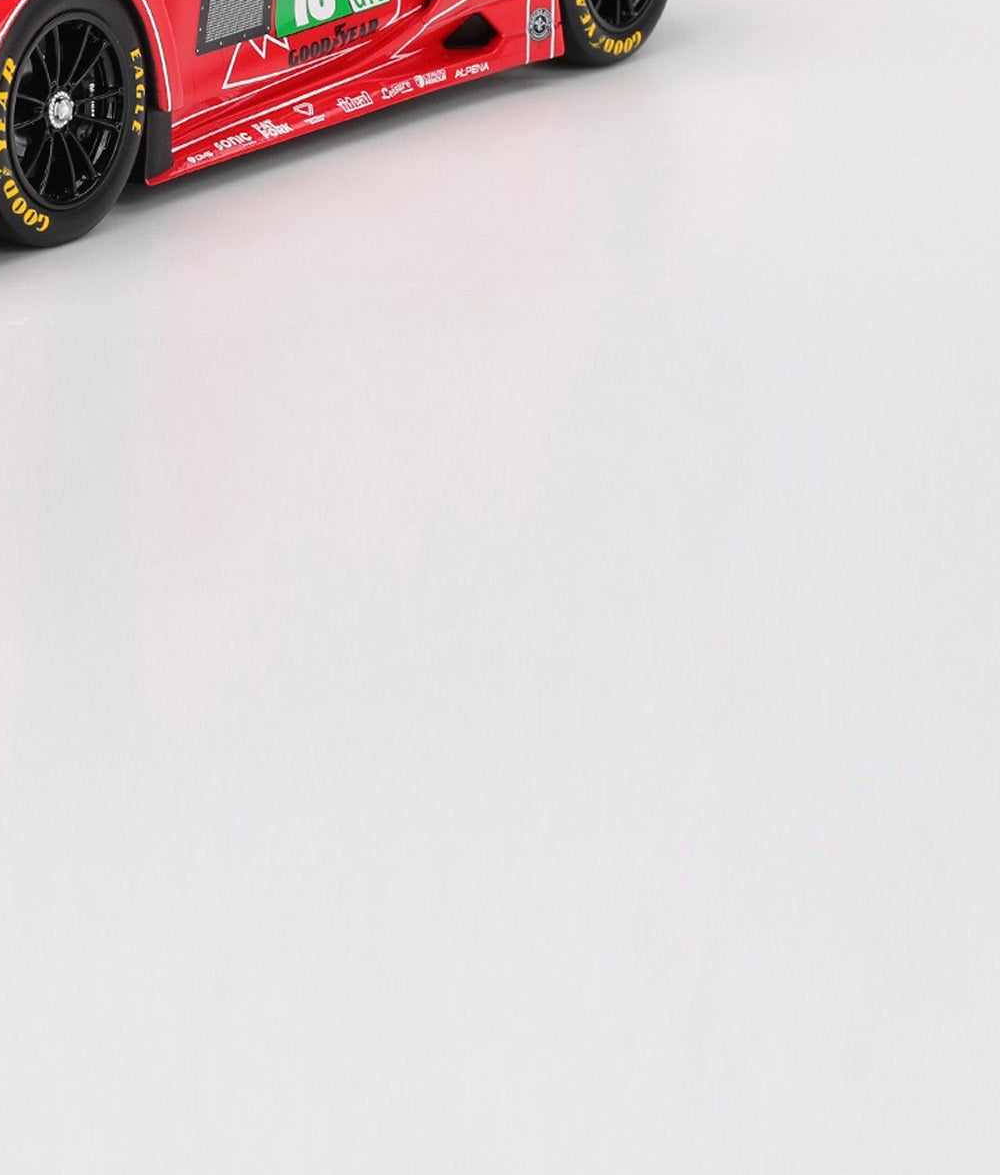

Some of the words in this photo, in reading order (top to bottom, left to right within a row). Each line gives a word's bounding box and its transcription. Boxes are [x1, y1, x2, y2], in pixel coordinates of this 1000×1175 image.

[288, 18, 379, 66] GOODYEAR
[130, 47, 146, 135] EAGLE
[454, 62, 490, 79] ALPENA
